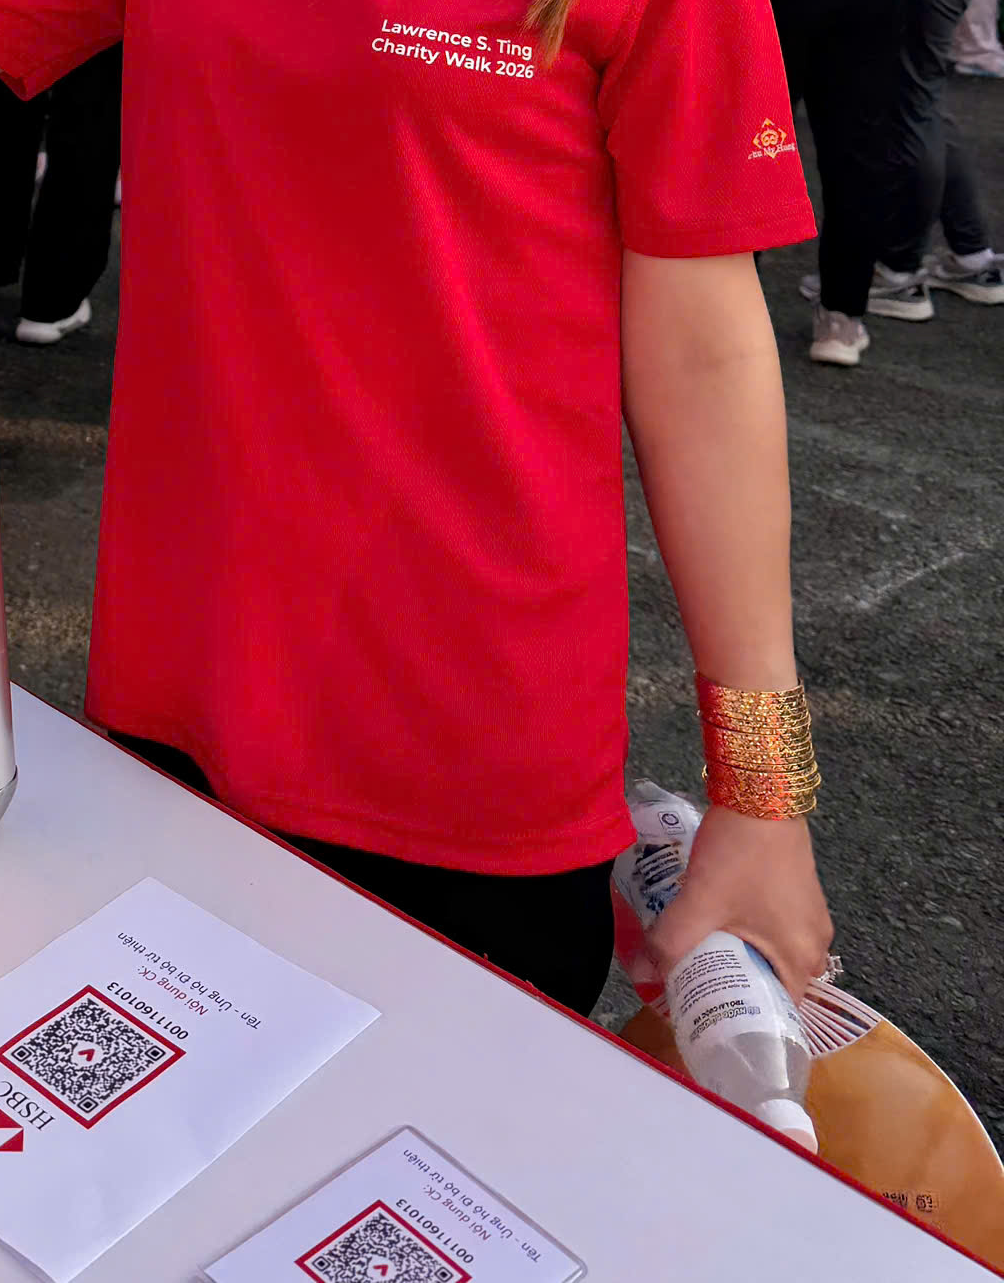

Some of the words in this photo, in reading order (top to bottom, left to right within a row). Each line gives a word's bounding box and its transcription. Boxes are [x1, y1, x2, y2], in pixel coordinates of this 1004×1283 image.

[381, 19, 472, 48] Lawrence
[476, 36, 491, 51] S.
[495, 39, 533, 61] Ting
[371, 38, 440, 64] Charity
[445, 50, 491, 73] Walk
[495, 61, 535, 79] 2026
[117, 932, 146, 954] thiện
[145, 952, 161, 963] từ
[137, 965, 157, 982] CK:
[160, 961, 177, 975] bộ
[175, 971, 191, 984] Đi
[157, 977, 187, 1000] dung
[190, 981, 208, 996] hộ
[107, 981, 189, 1040] 00111601013
[186, 998, 209, 1016] Nội
[208, 990, 233, 1012] Ủng
[240, 1012, 262, 1029] Tên
[403, 1149, 431, 1173] thiện
[423, 1184, 442, 1200] CK:
[443, 1182, 460, 1197] bộ
[442, 1198, 471, 1222] dung
[460, 1194, 474, 1207] Đi
[472, 1205, 490, 1219] hộ
[396, 1198, 474, 1264] 00111601013
[469, 1221, 492, 1241] Nội
[521, 1242, 542, 1263] Tên
